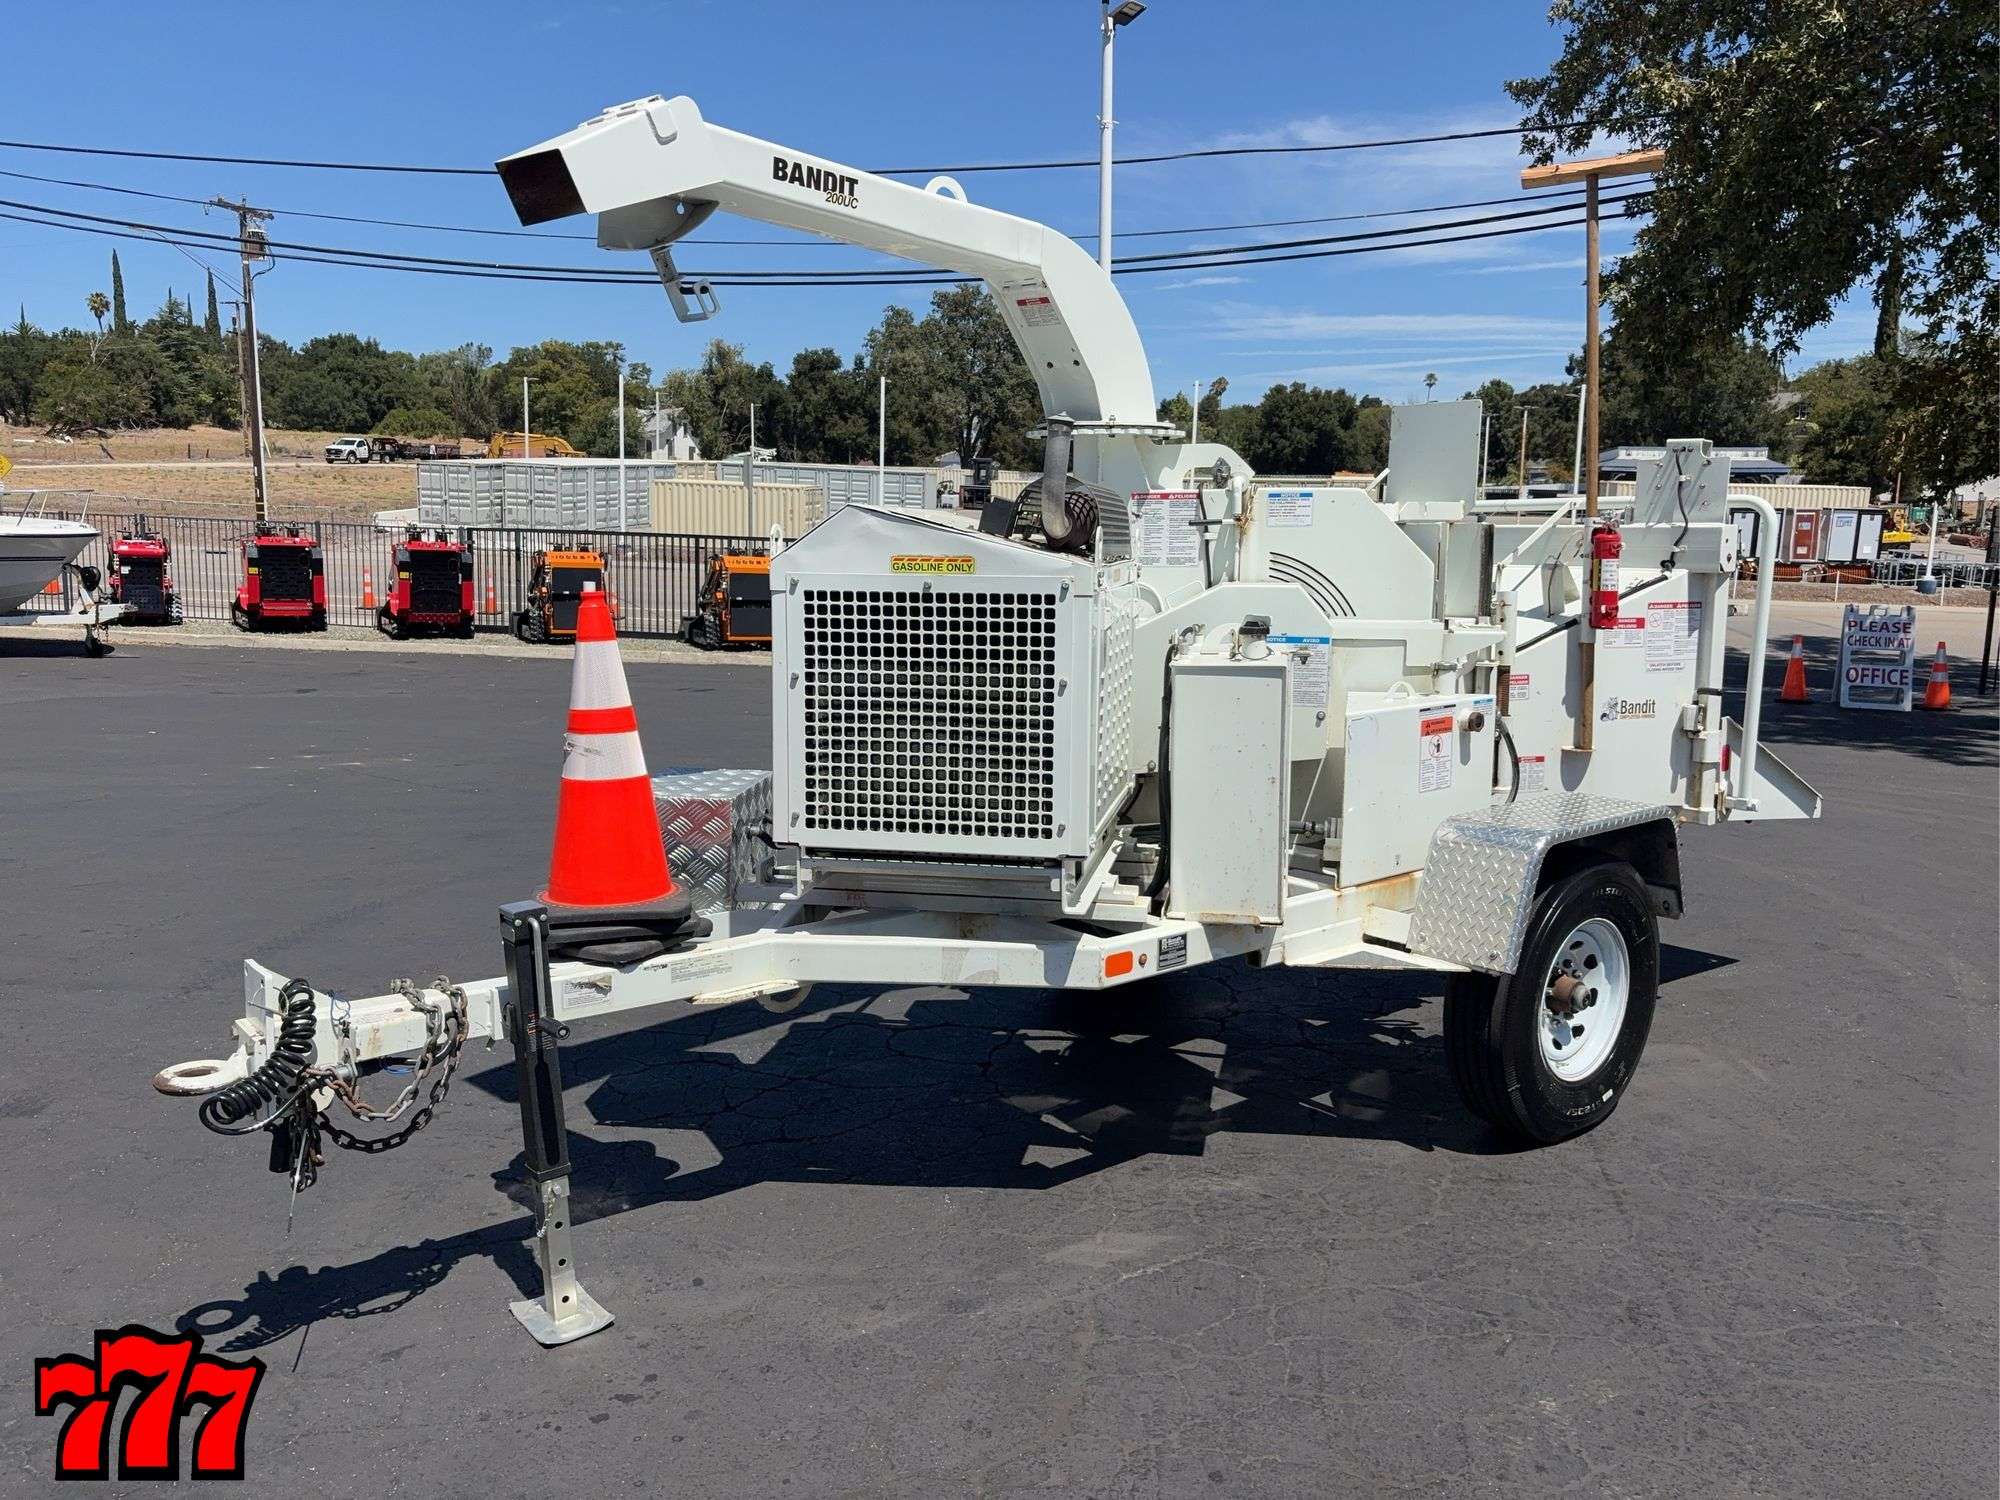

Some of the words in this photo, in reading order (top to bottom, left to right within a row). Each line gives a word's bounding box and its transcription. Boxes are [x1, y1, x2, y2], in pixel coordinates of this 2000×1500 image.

[773, 156, 859, 197] BANDIT
[825, 191, 859, 209] 200UC
[892, 562, 944, 572] GASOLINE
[946, 563, 974, 572] ONLY
[1848, 620, 1912, 634] PLEASE
[1847, 635, 1882, 647] CHECK
[1884, 636, 1895, 648] IN
[1898, 637, 1911, 649] AT
[1846, 667, 1909, 685] OFFICE
[1620, 699, 1656, 714] Bandit
